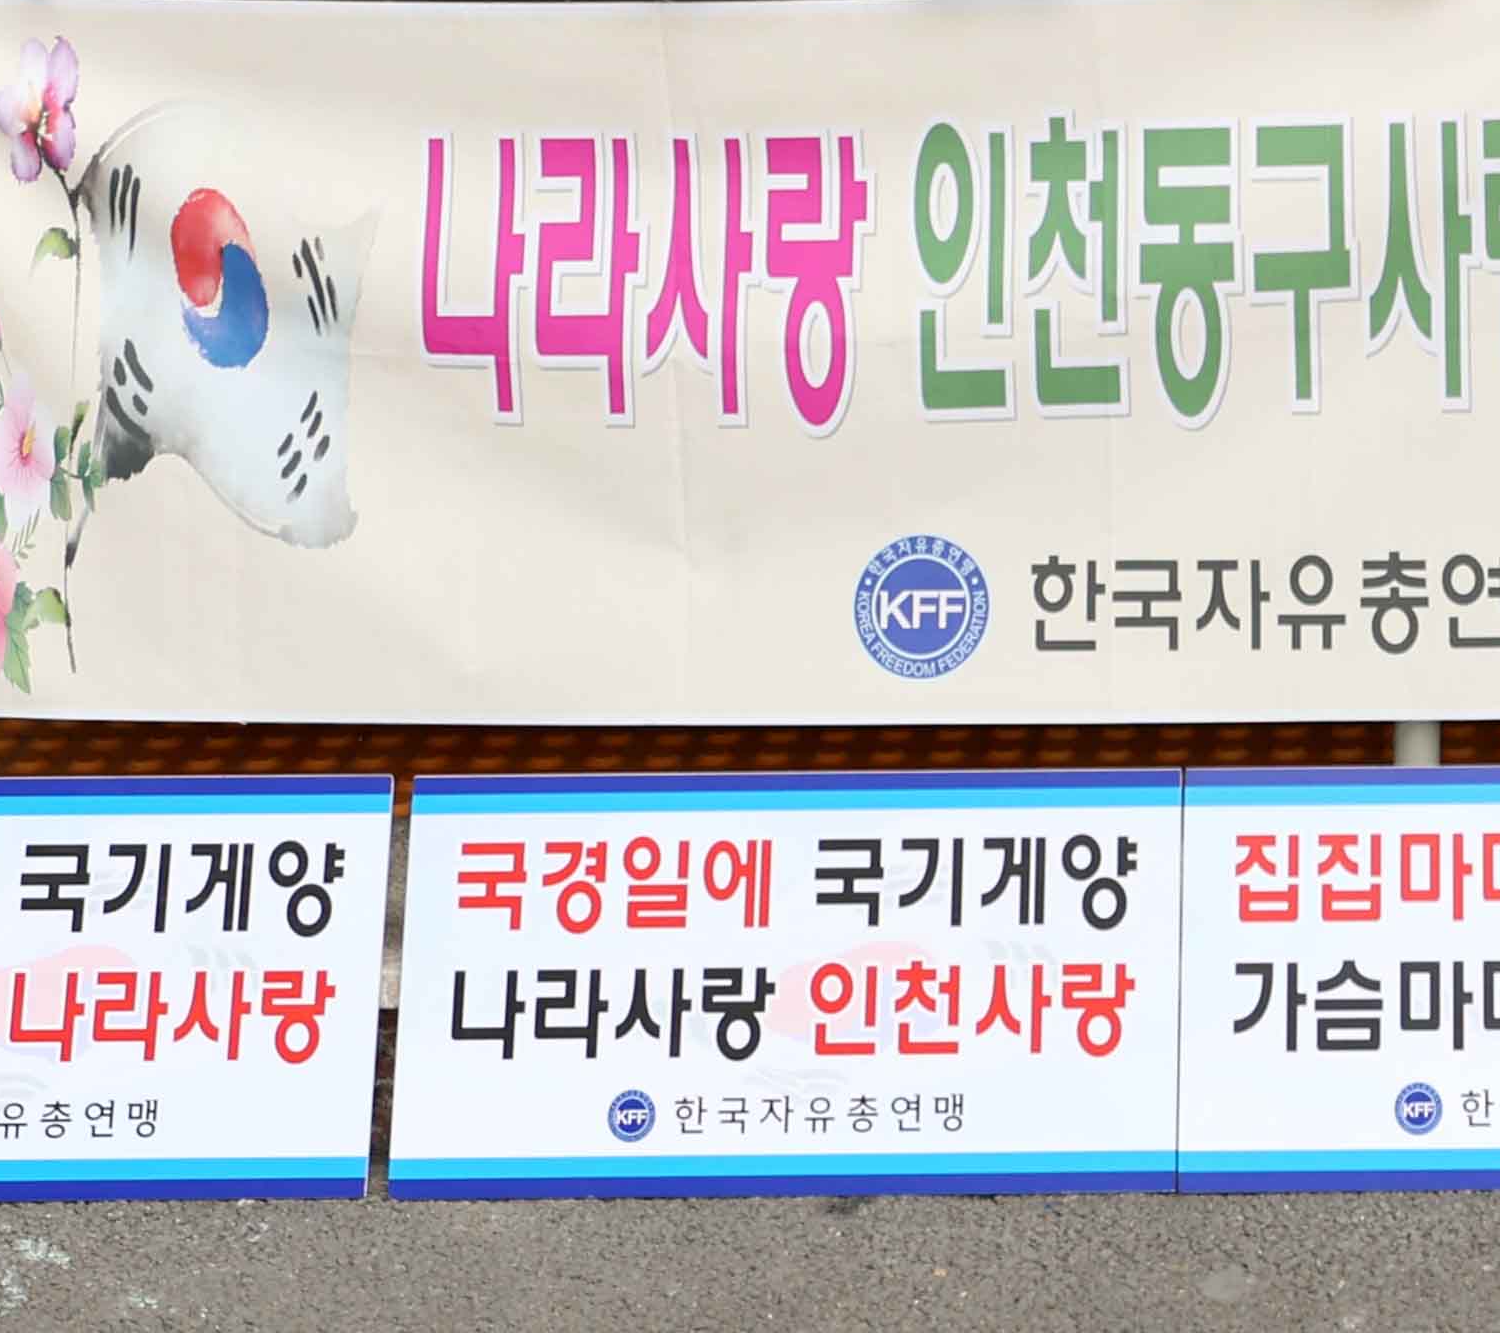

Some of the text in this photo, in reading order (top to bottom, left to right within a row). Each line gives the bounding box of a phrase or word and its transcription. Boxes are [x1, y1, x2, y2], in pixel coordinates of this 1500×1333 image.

[421, 133, 868, 427] 나라사랑
[871, 643, 937, 678] FREEDOM
[937, 590, 987, 673] FEDERATION
[879, 590, 965, 630] KFF
[19, 839, 346, 938] 국기게양
[457, 833, 1138, 934] 국경일에 국기게양
[9, 968, 336, 1064] 나라사랑
[450, 961, 1136, 1061] 나라사랑 인천사랑
[674, 1092, 967, 1135] 한국자유총연맹
